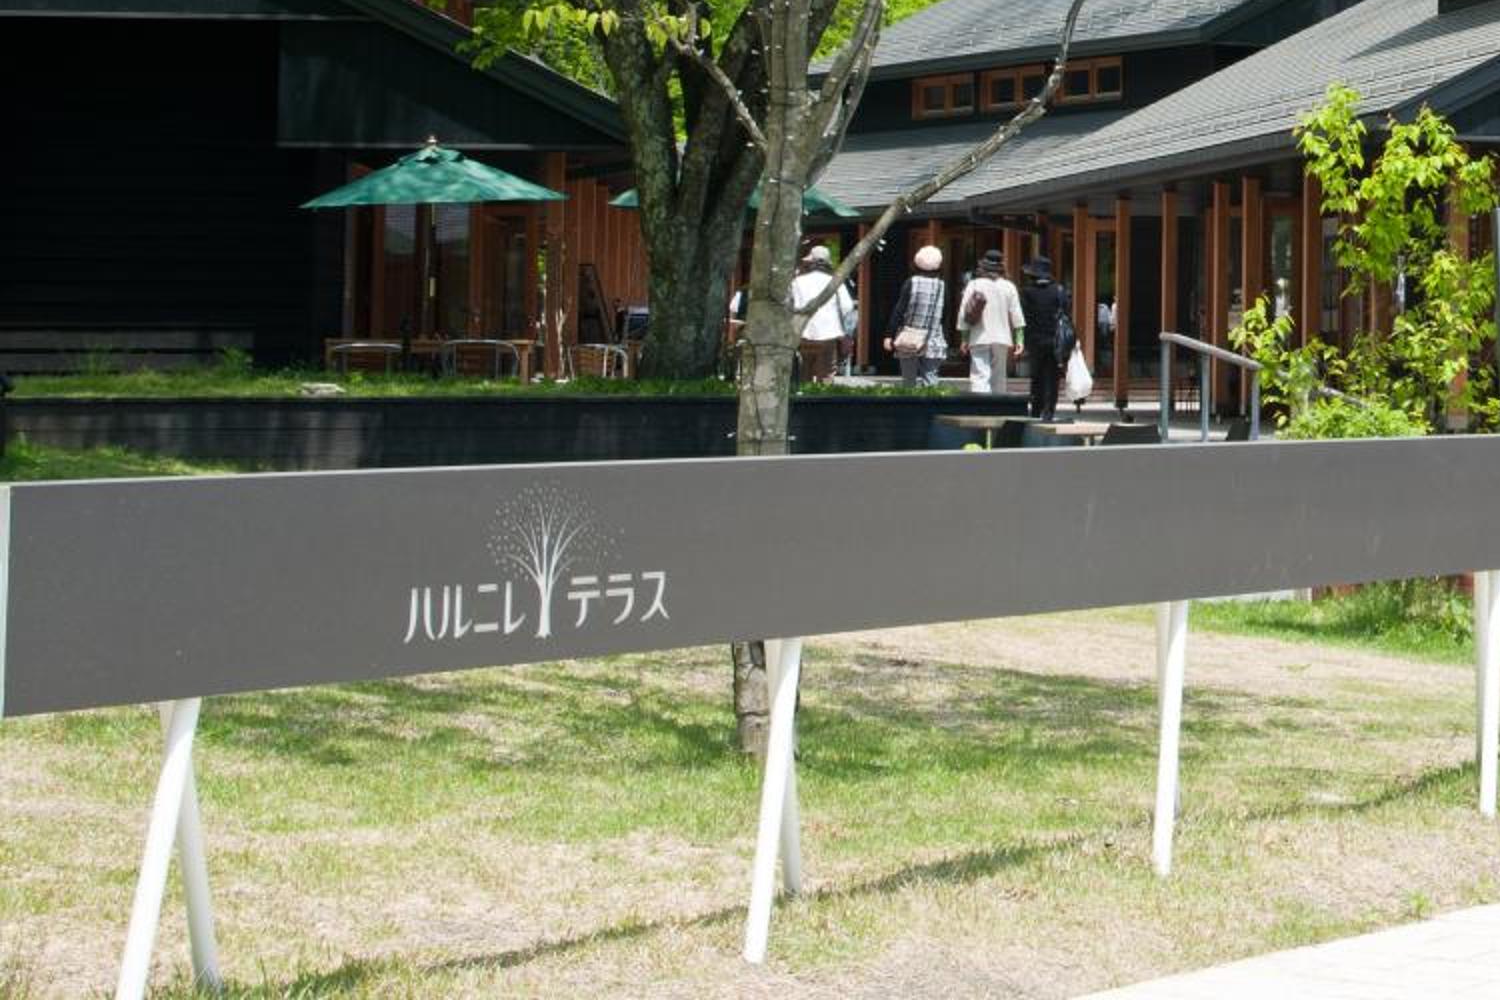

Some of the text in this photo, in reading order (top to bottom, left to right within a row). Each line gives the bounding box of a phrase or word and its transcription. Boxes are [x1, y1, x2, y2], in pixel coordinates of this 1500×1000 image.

[403, 570, 670, 644] ハルニレ テラス
